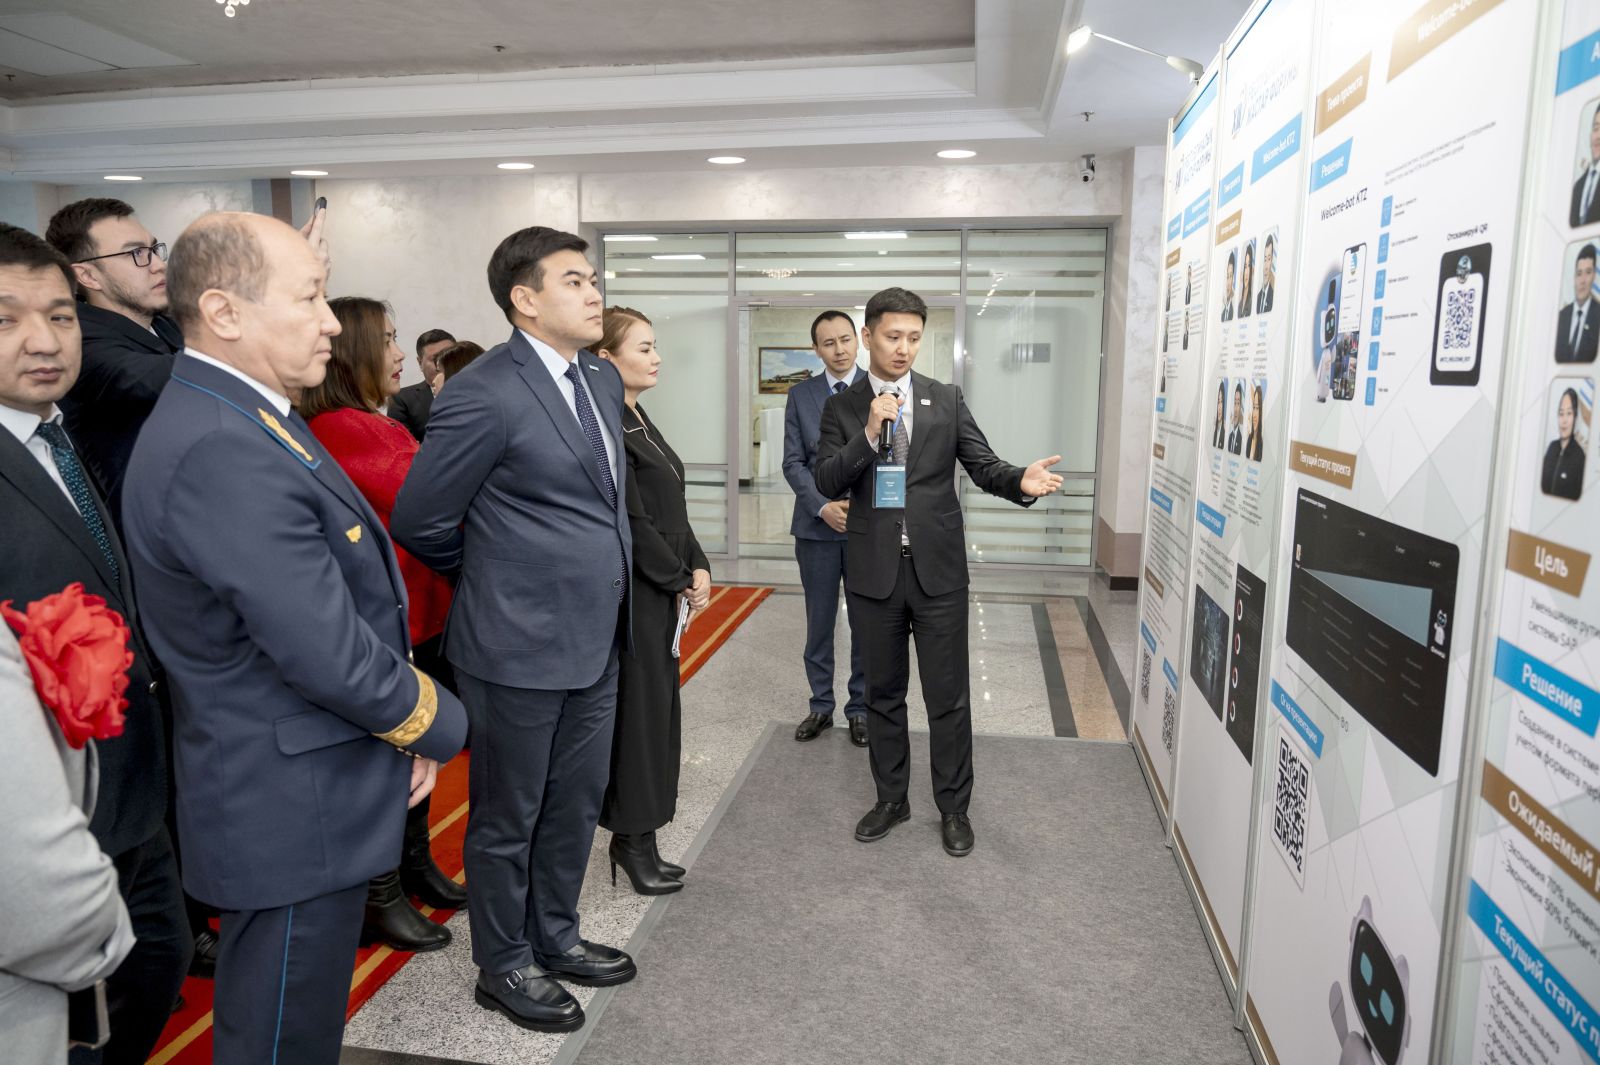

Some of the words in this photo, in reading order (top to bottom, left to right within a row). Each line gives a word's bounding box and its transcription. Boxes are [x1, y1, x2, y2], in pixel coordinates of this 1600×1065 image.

[1340, 75, 1363, 105] проекта
[1321, 156, 1345, 178] Решение
[1320, 195, 1355, 221] Welcome-bot
[1355, 187, 1368, 204] KTZ
[1480, 222, 1488, 234] QR
[1299, 450, 1318, 468] Текущий
[1317, 458, 1332, 472] статус
[1331, 461, 1351, 477] проекта
[1534, 545, 1568, 578] Цель
[1527, 620, 1559, 643] системы
[1560, 632, 1577, 651] SAP
[1522, 662, 1582, 717] Решение
[1518, 709, 1555, 745] Создание
[1556, 738, 1562, 750] в
[1515, 732, 1543, 759] учетом
[1543, 750, 1580, 787] формата
[1508, 790, 1594, 878] Ожидаемый
[1547, 875, 1564, 902] 70%
[1544, 897, 1561, 925] 50%
[1494, 913, 1544, 985] Текущий
[1544, 977, 1588, 1035] статус
